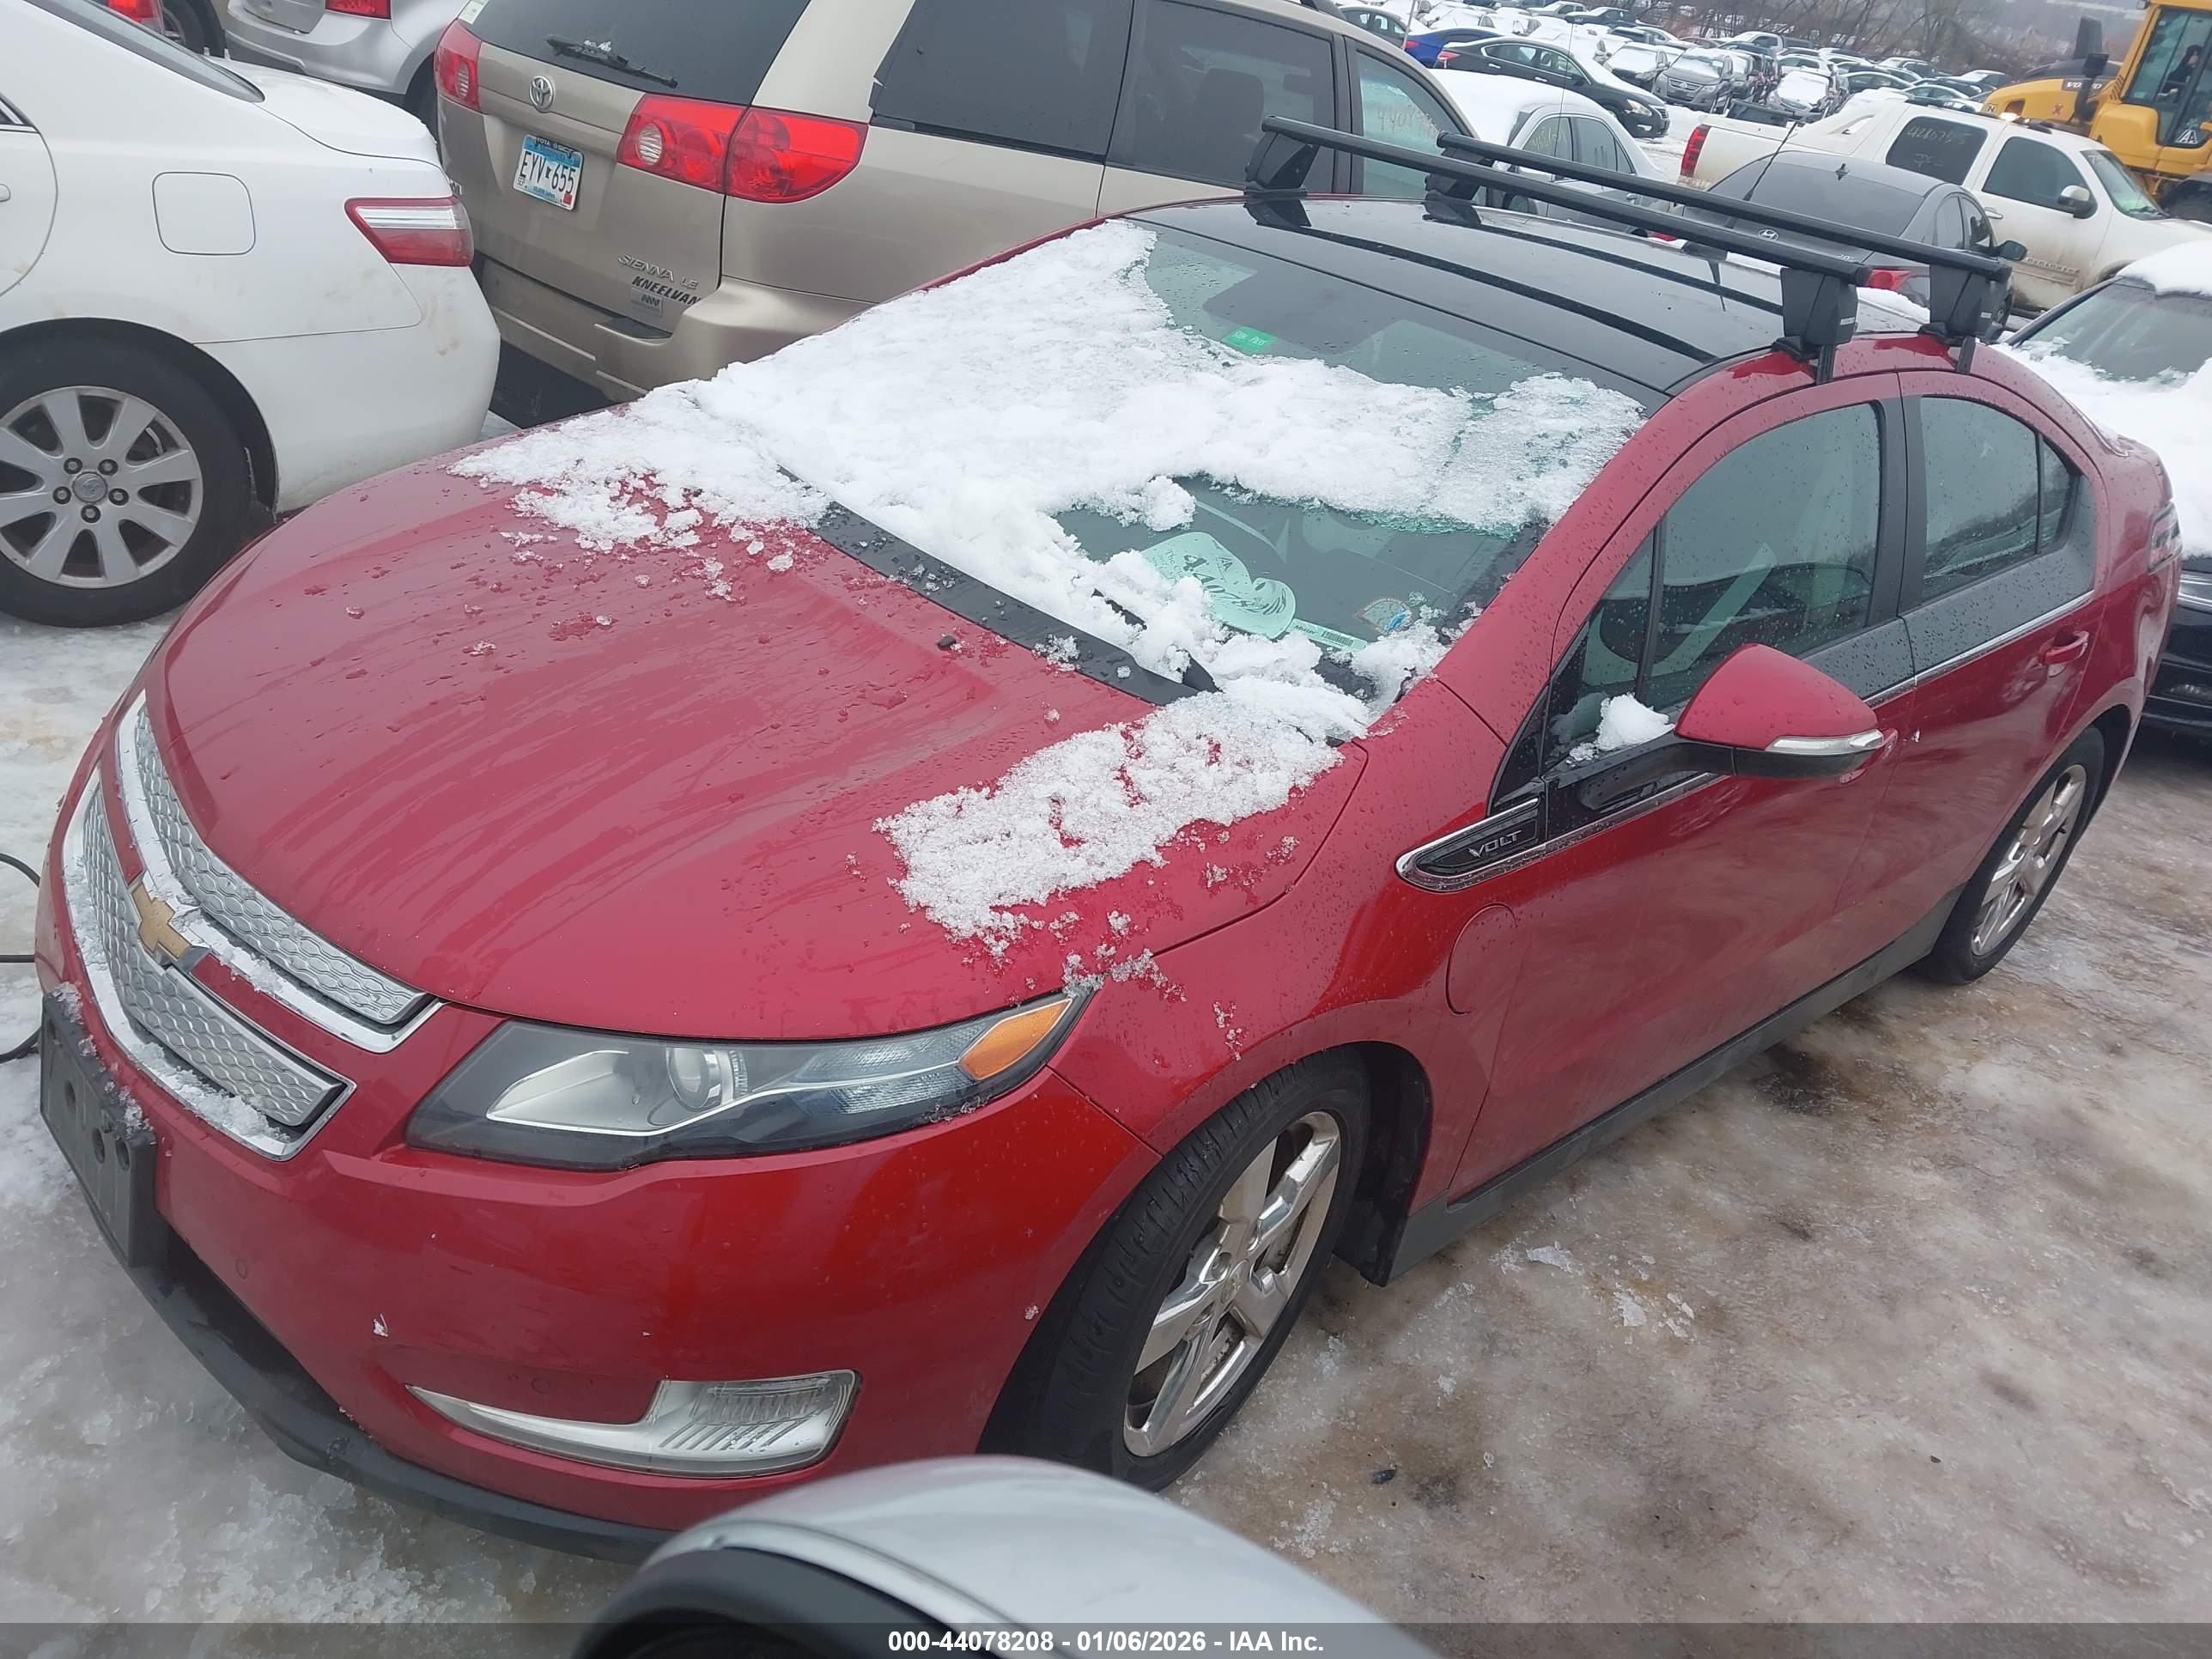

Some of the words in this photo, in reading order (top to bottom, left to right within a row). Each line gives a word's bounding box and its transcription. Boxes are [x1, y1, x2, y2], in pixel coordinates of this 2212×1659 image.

[2067, 81, 2103, 89] VOO
[520, 151, 547, 184] EYV
[551, 163, 576, 194] 655
[617, 254, 674, 283] SIENNA
[680, 276, 699, 290] LE
[631, 276, 702, 306] KNEELVAN
[1468, 829, 1523, 859] VOLT
